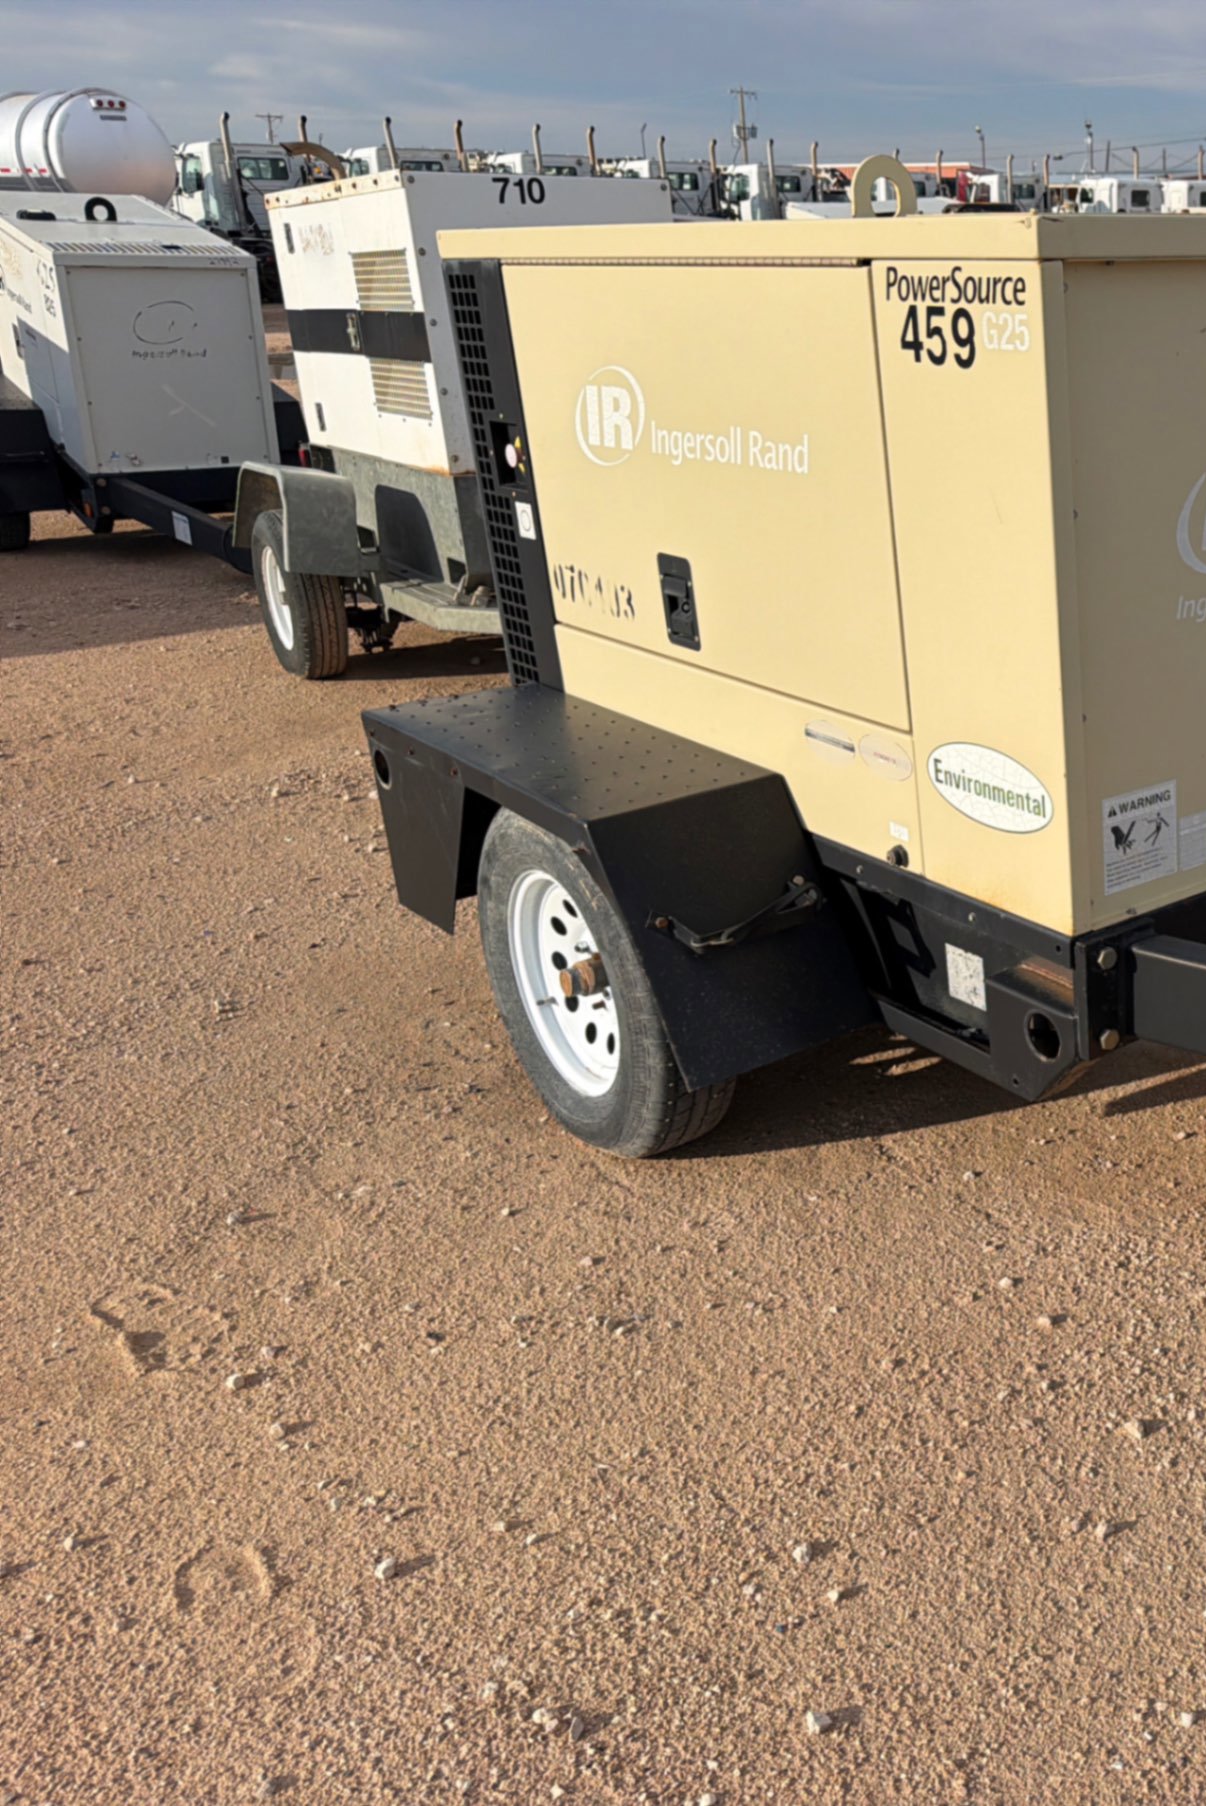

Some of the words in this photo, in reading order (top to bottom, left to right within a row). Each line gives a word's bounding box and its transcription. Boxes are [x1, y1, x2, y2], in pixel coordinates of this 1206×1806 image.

[492, 177, 546, 204] 710
[886, 266, 1026, 306] PowerSource
[900, 304, 976, 369] 459
[981, 311, 1030, 352] G25
[585, 384, 633, 450] IR
[650, 420, 742, 466] Ingersoll
[749, 430, 809, 474] Rand
[932, 757, 1046, 818] Environmental
[1118, 789, 1172, 814] WARNING
